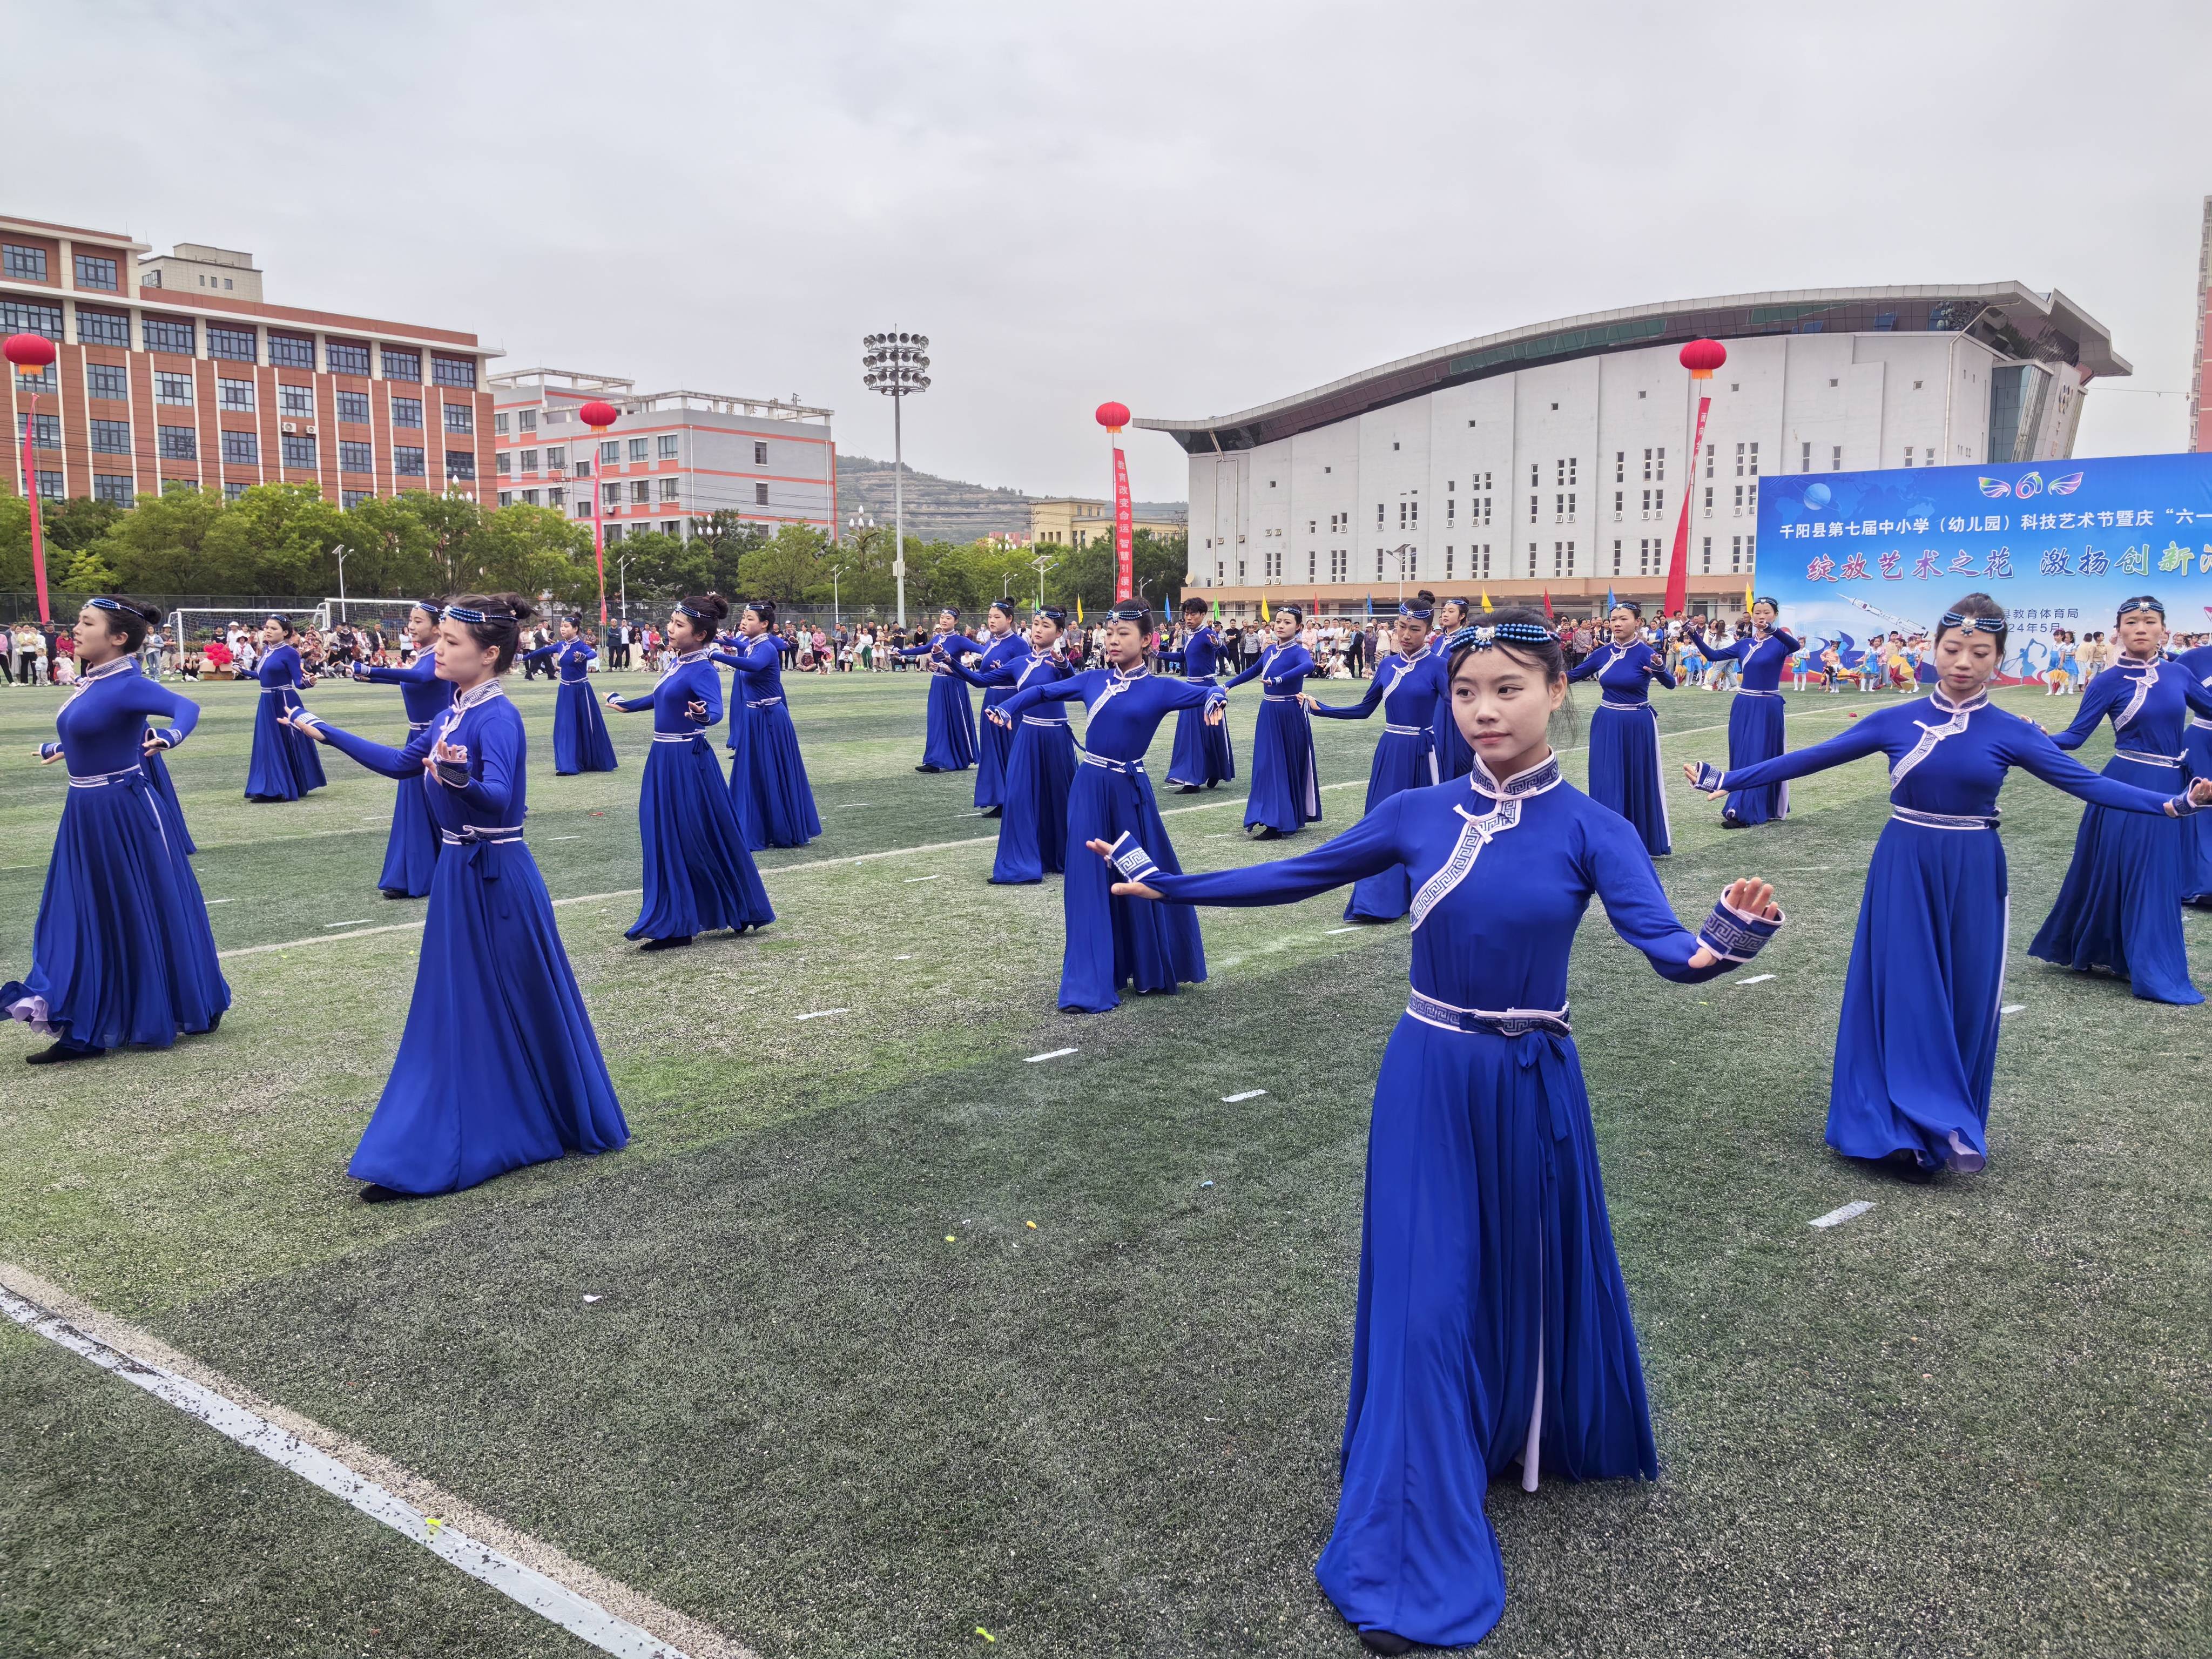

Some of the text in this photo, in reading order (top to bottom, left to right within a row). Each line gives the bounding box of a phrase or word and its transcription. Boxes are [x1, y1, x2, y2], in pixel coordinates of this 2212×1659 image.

[1117, 460, 1130, 598] 教育改变命运 智慧引领灿
[1806, 545, 2014, 582] 绽放艺术之花
